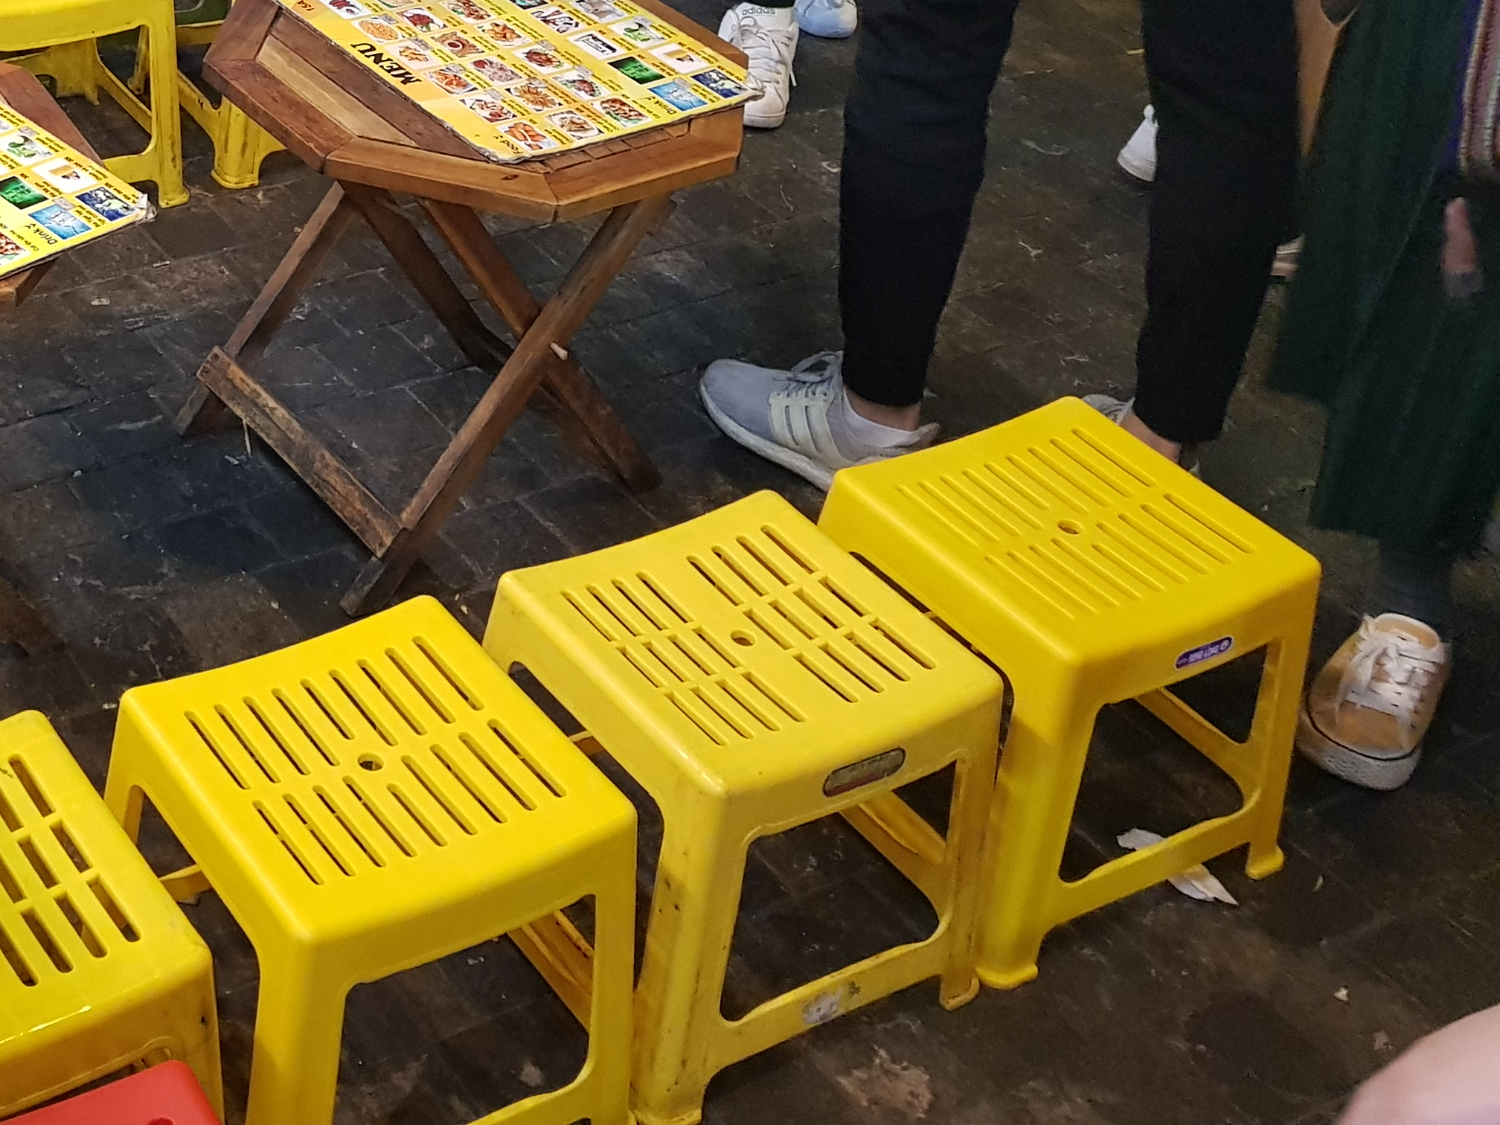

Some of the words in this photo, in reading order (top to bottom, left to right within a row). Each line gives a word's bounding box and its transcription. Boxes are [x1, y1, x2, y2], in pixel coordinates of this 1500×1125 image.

[742, 7, 776, 16] adidas
[350, 42, 423, 86] MENU
[653, 98, 677, 116] Drink
[38, 227, 58, 246] Drink
